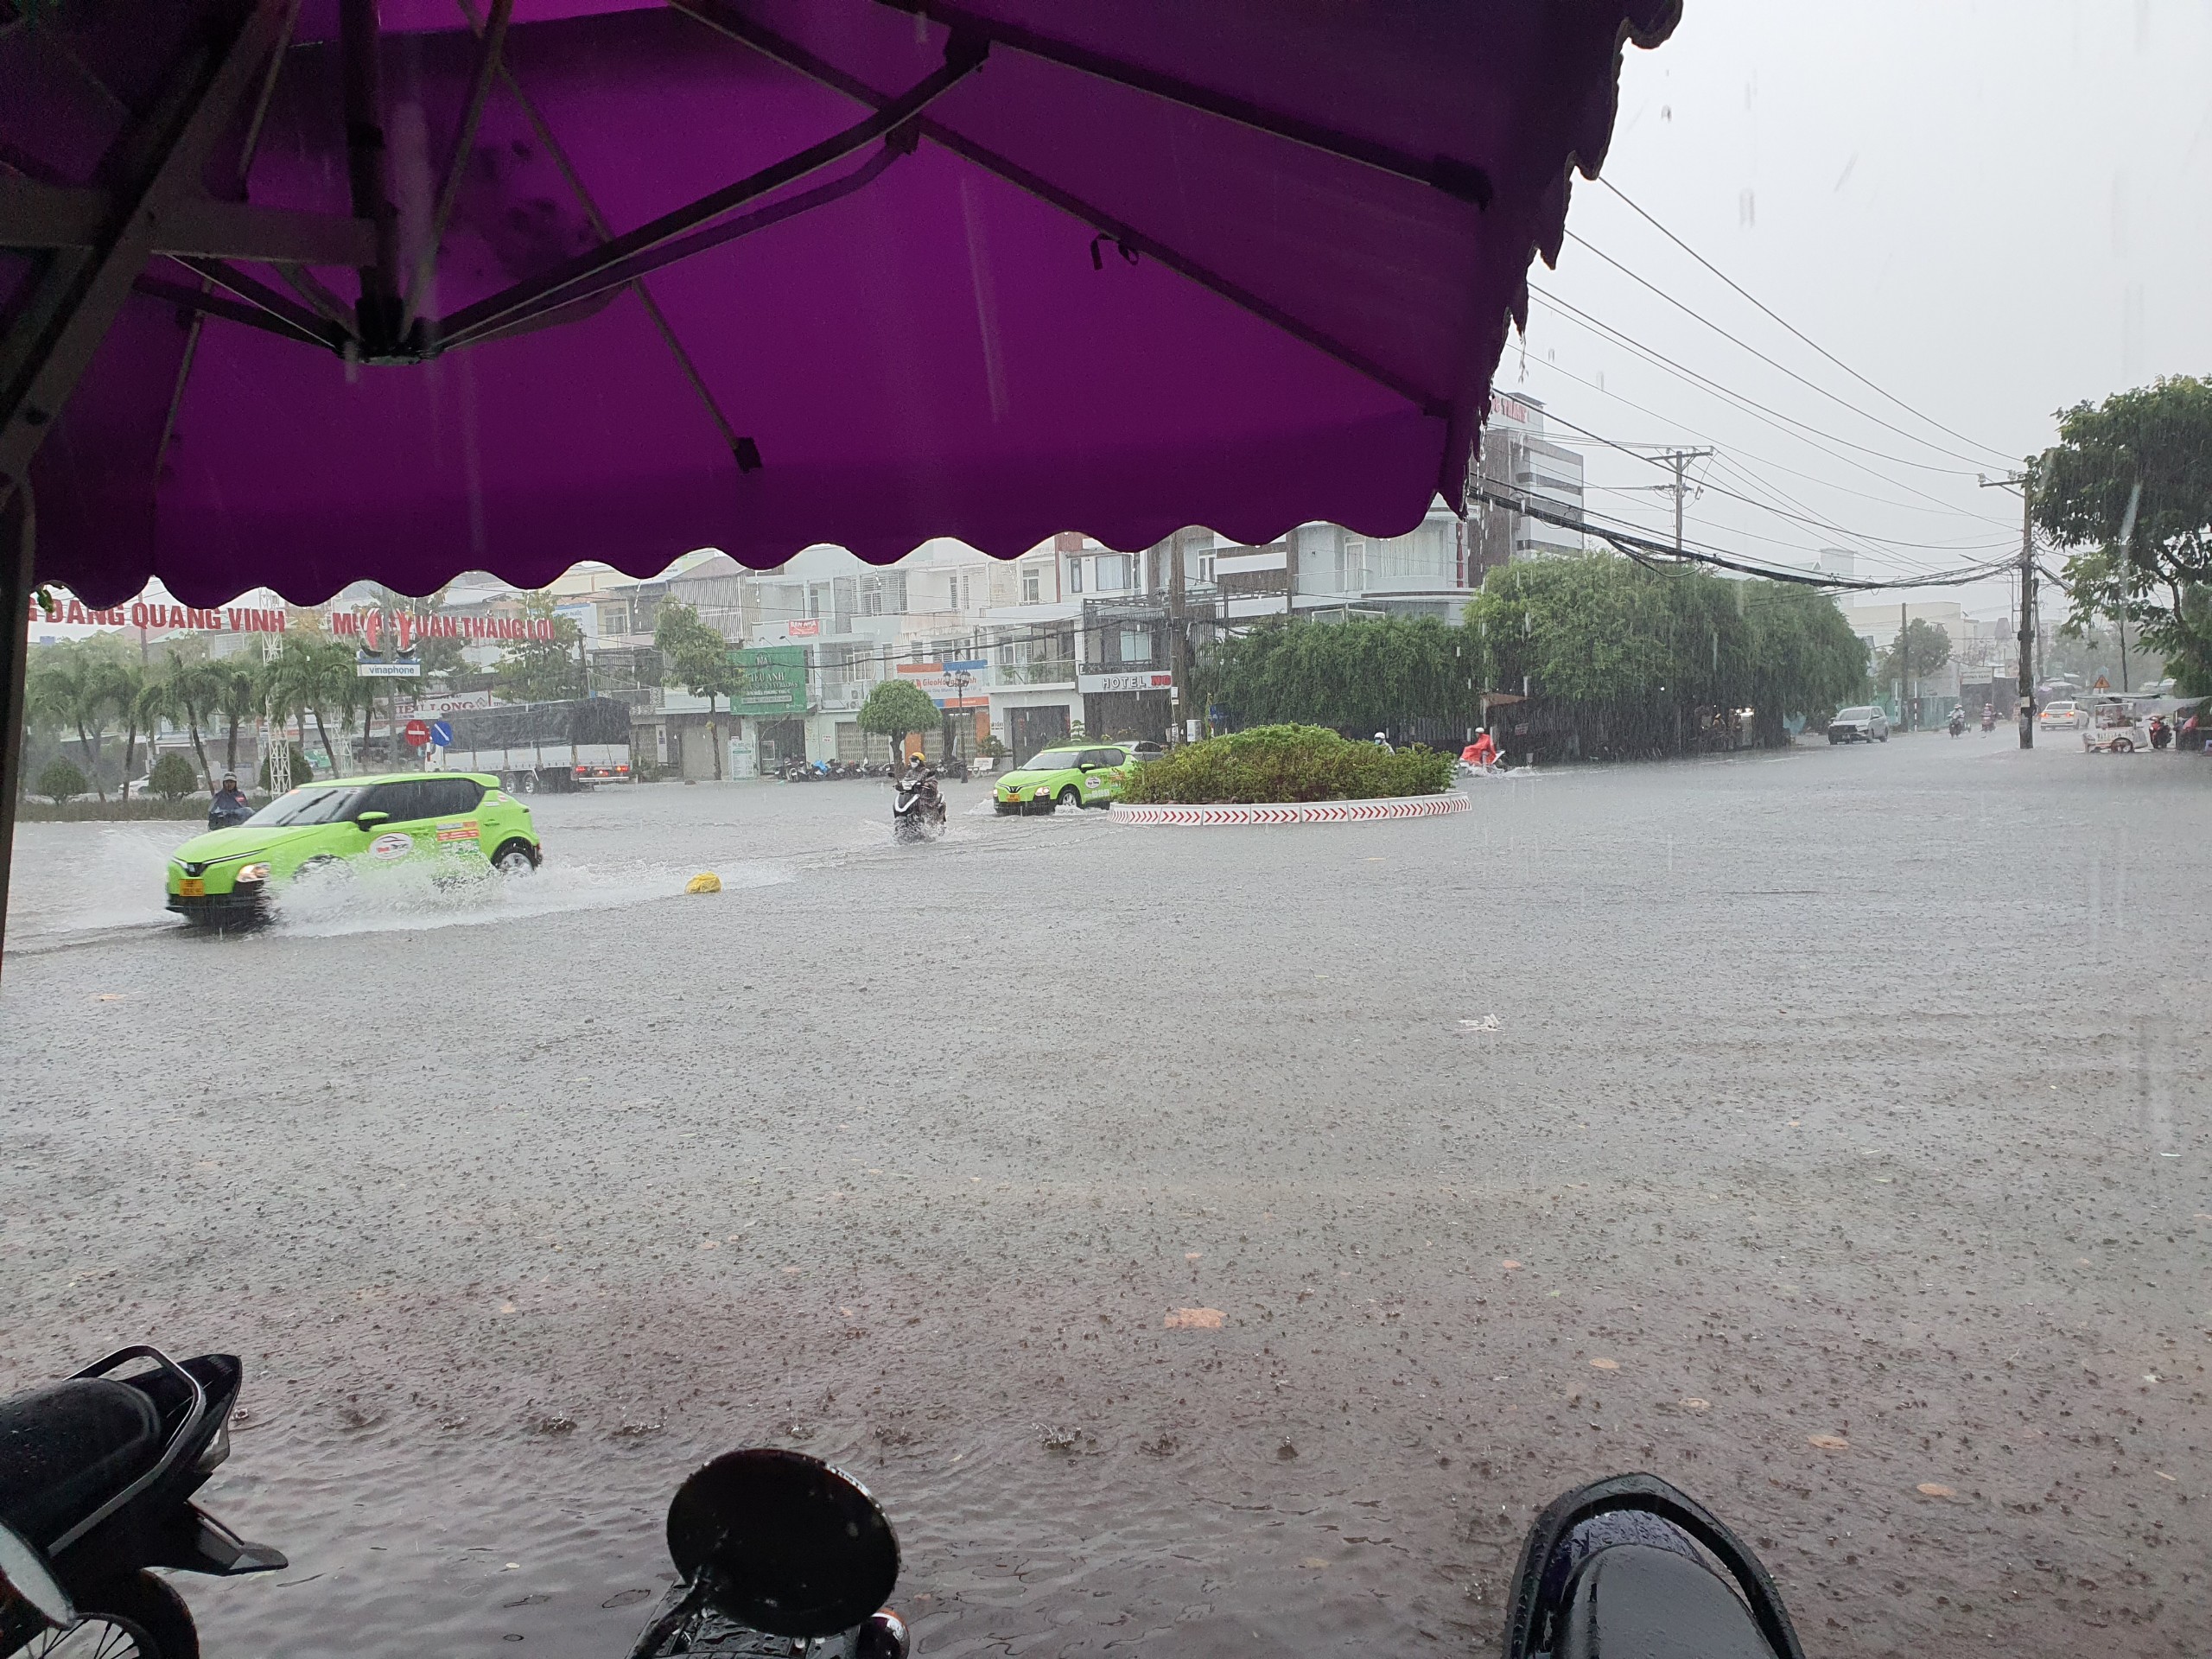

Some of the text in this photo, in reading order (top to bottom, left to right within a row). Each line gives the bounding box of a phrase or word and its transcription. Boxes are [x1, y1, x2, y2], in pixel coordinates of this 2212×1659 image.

[227, 608, 285, 632] VINH
[369, 665, 415, 676] vinaphone
[1103, 676, 1146, 689] HOTEL
